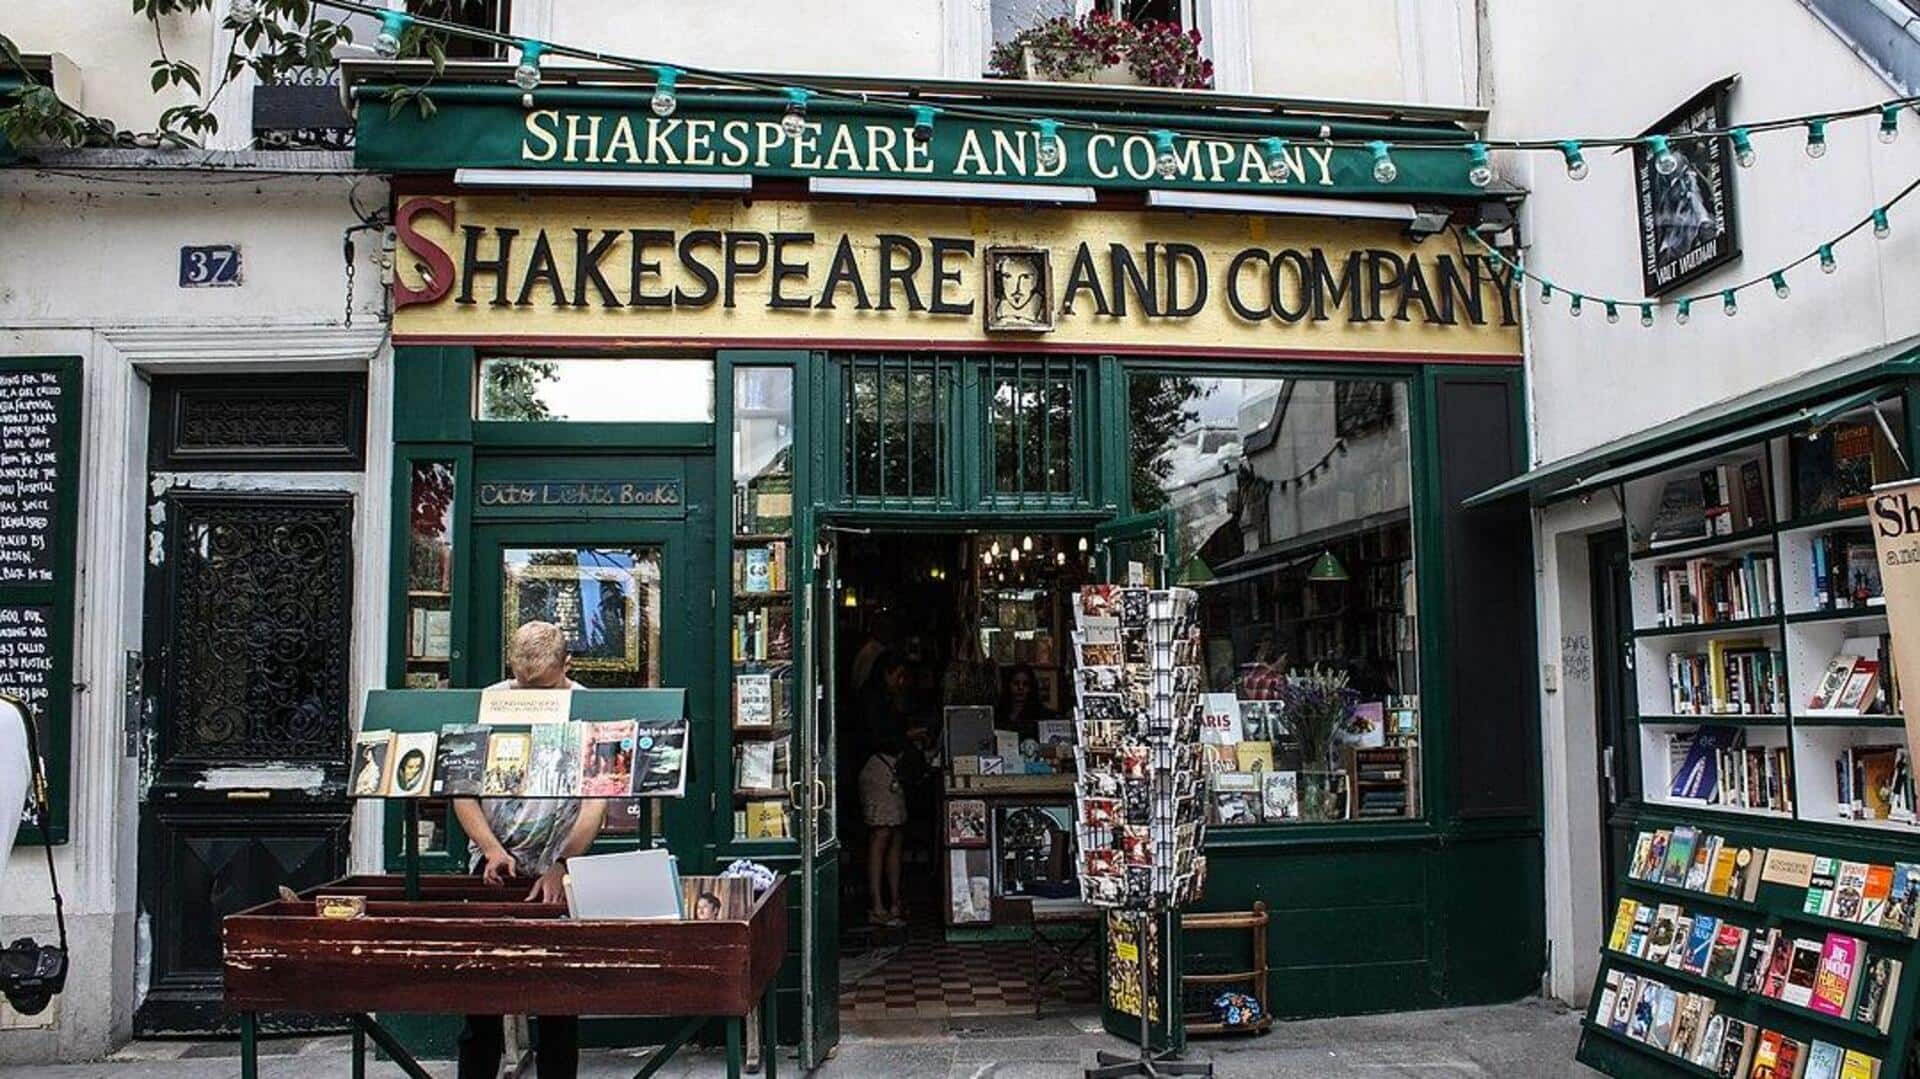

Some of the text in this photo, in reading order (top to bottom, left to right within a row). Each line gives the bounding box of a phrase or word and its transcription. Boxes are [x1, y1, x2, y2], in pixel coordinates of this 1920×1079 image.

[522, 109, 1334, 186] SHAKESPEARE AND COMPANY
[189, 251, 232, 282] 37
[393, 196, 1520, 327] SHAKESPEARE AND COMPANY
[31, 533, 45, 550] BY
[1200, 713, 1232, 729] RIS
